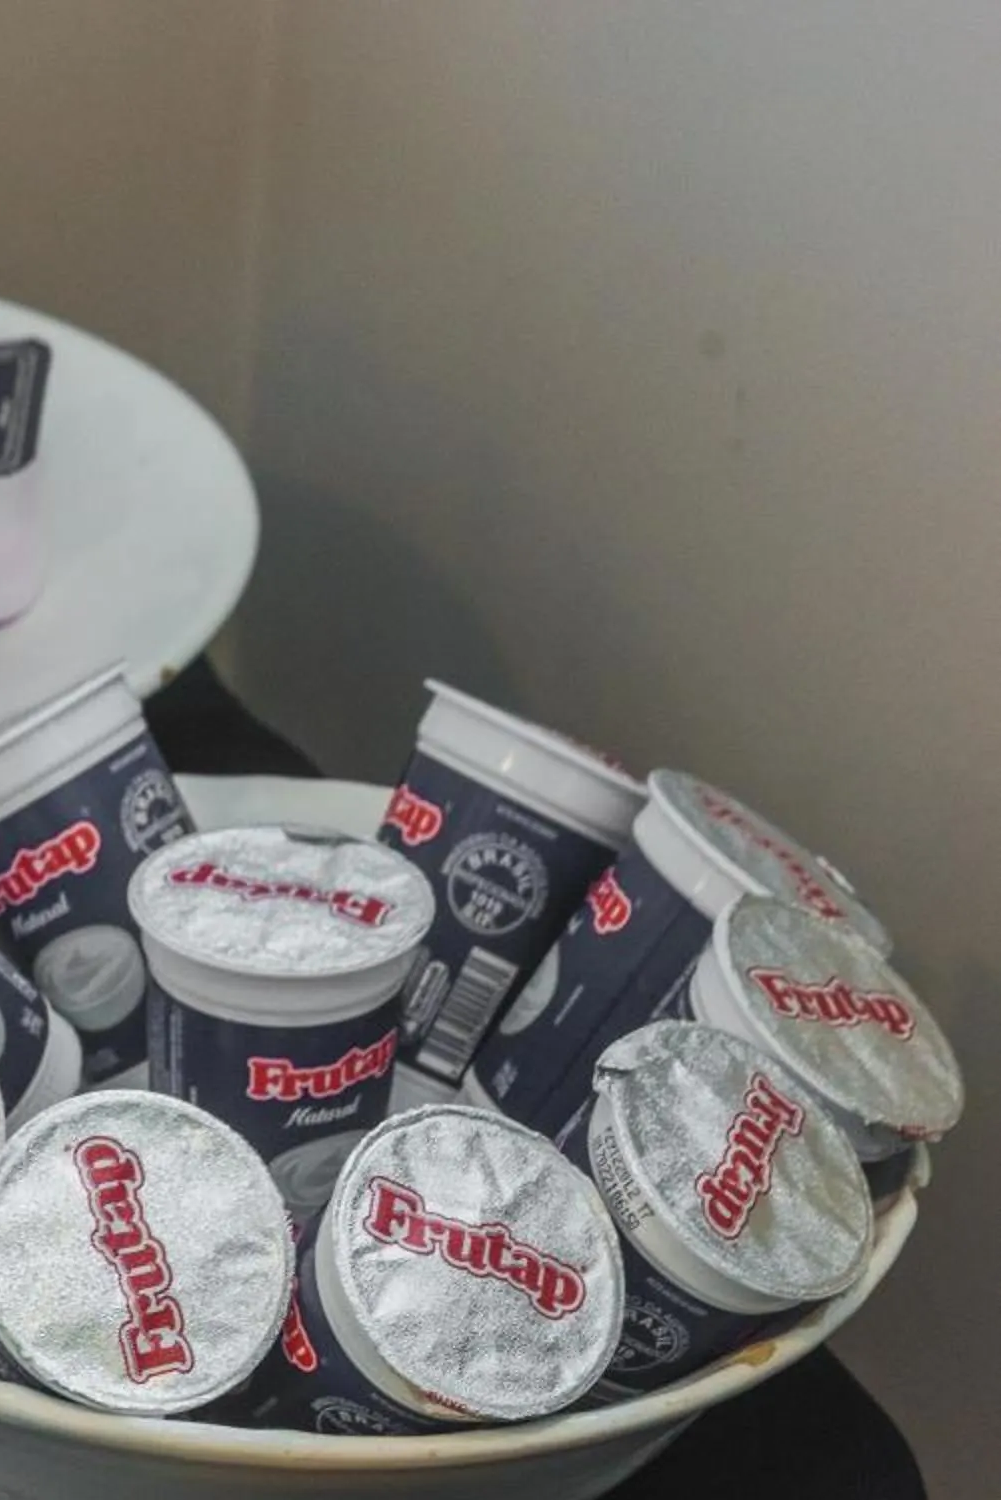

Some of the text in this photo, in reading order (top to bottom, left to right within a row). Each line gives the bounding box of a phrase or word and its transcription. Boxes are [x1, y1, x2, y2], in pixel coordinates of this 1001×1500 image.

[748, 966, 916, 1041] Frutap
[282, 1093, 362, 1130] Natural
[696, 1071, 805, 1241] Frutap
[72, 1136, 193, 1385] Frutap
[368, 1176, 587, 1321] Frutap
